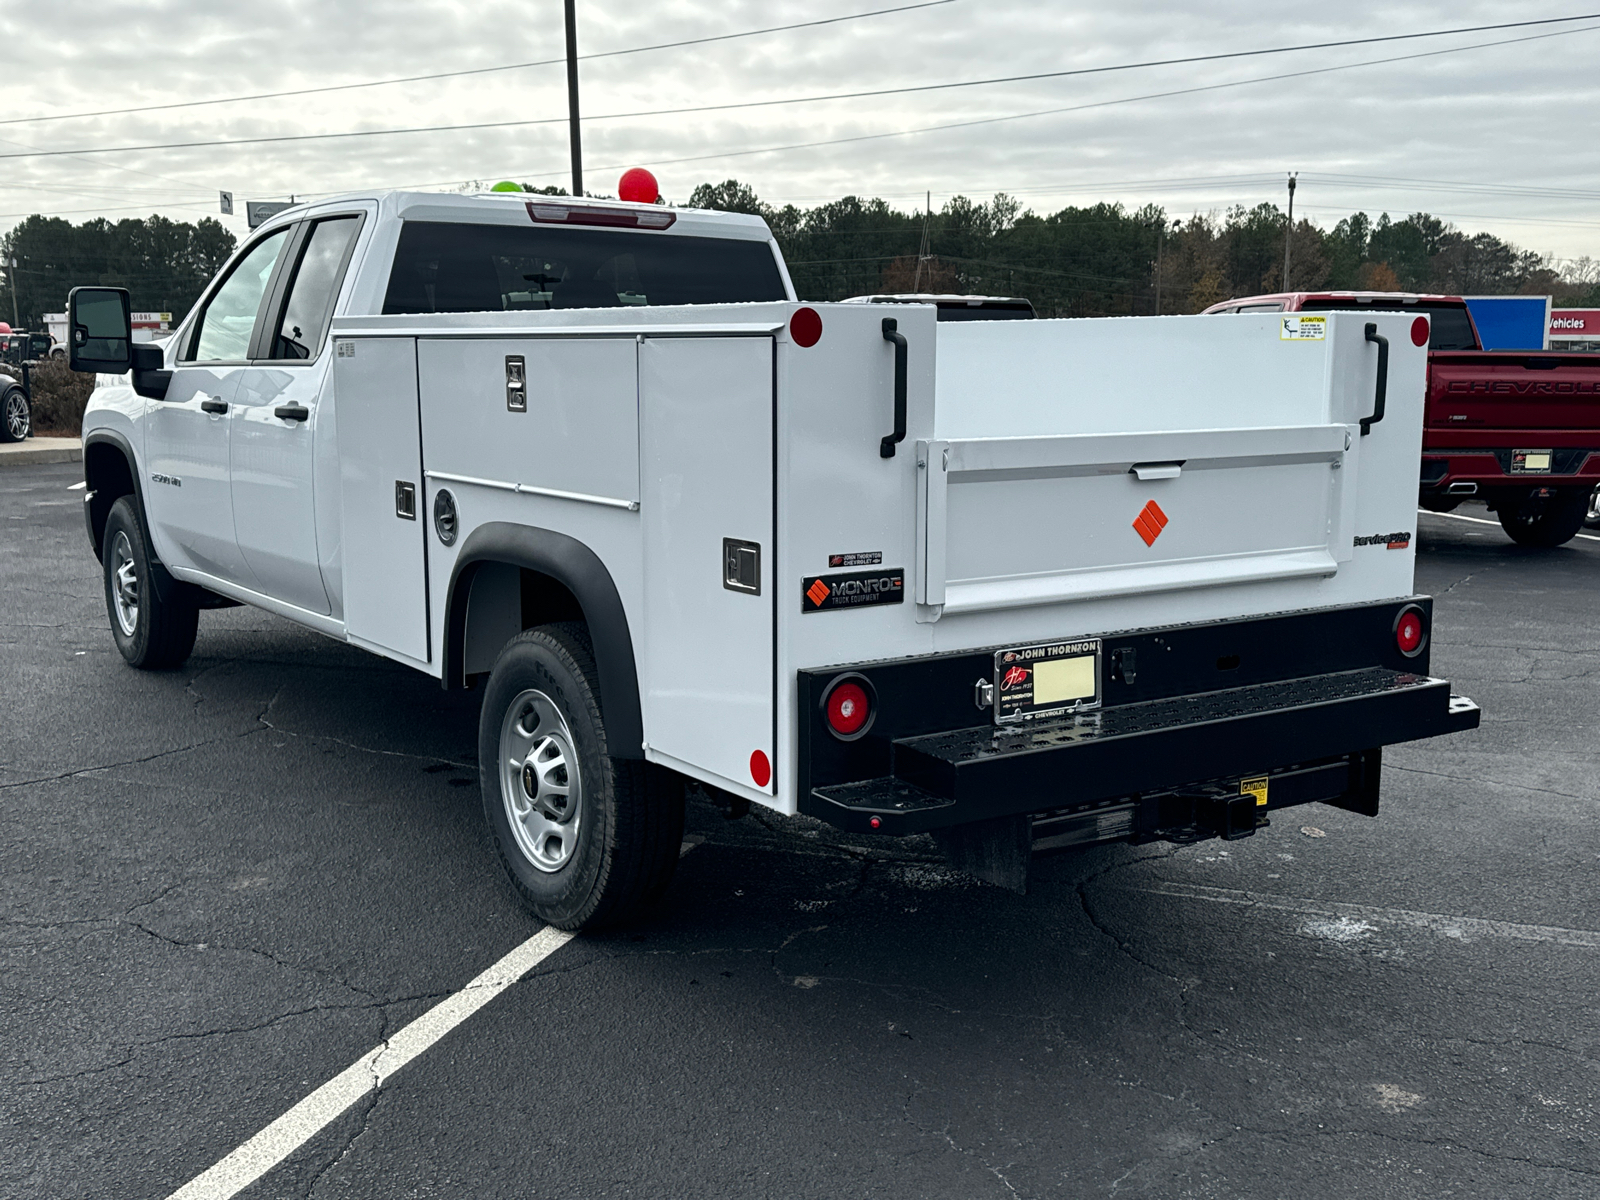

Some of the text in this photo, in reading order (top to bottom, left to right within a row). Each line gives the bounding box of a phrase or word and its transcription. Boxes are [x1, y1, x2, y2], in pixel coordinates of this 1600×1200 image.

[832, 577, 901, 596] MONROE
[832, 593, 879, 605] TRUCK EQUIPMENT
[1020, 649, 1045, 659] JOHN
[1047, 642, 1096, 655] THORNTON
[1035, 710, 1065, 719] CHEVROLET
[1243, 782, 1266, 790] CAUTION
